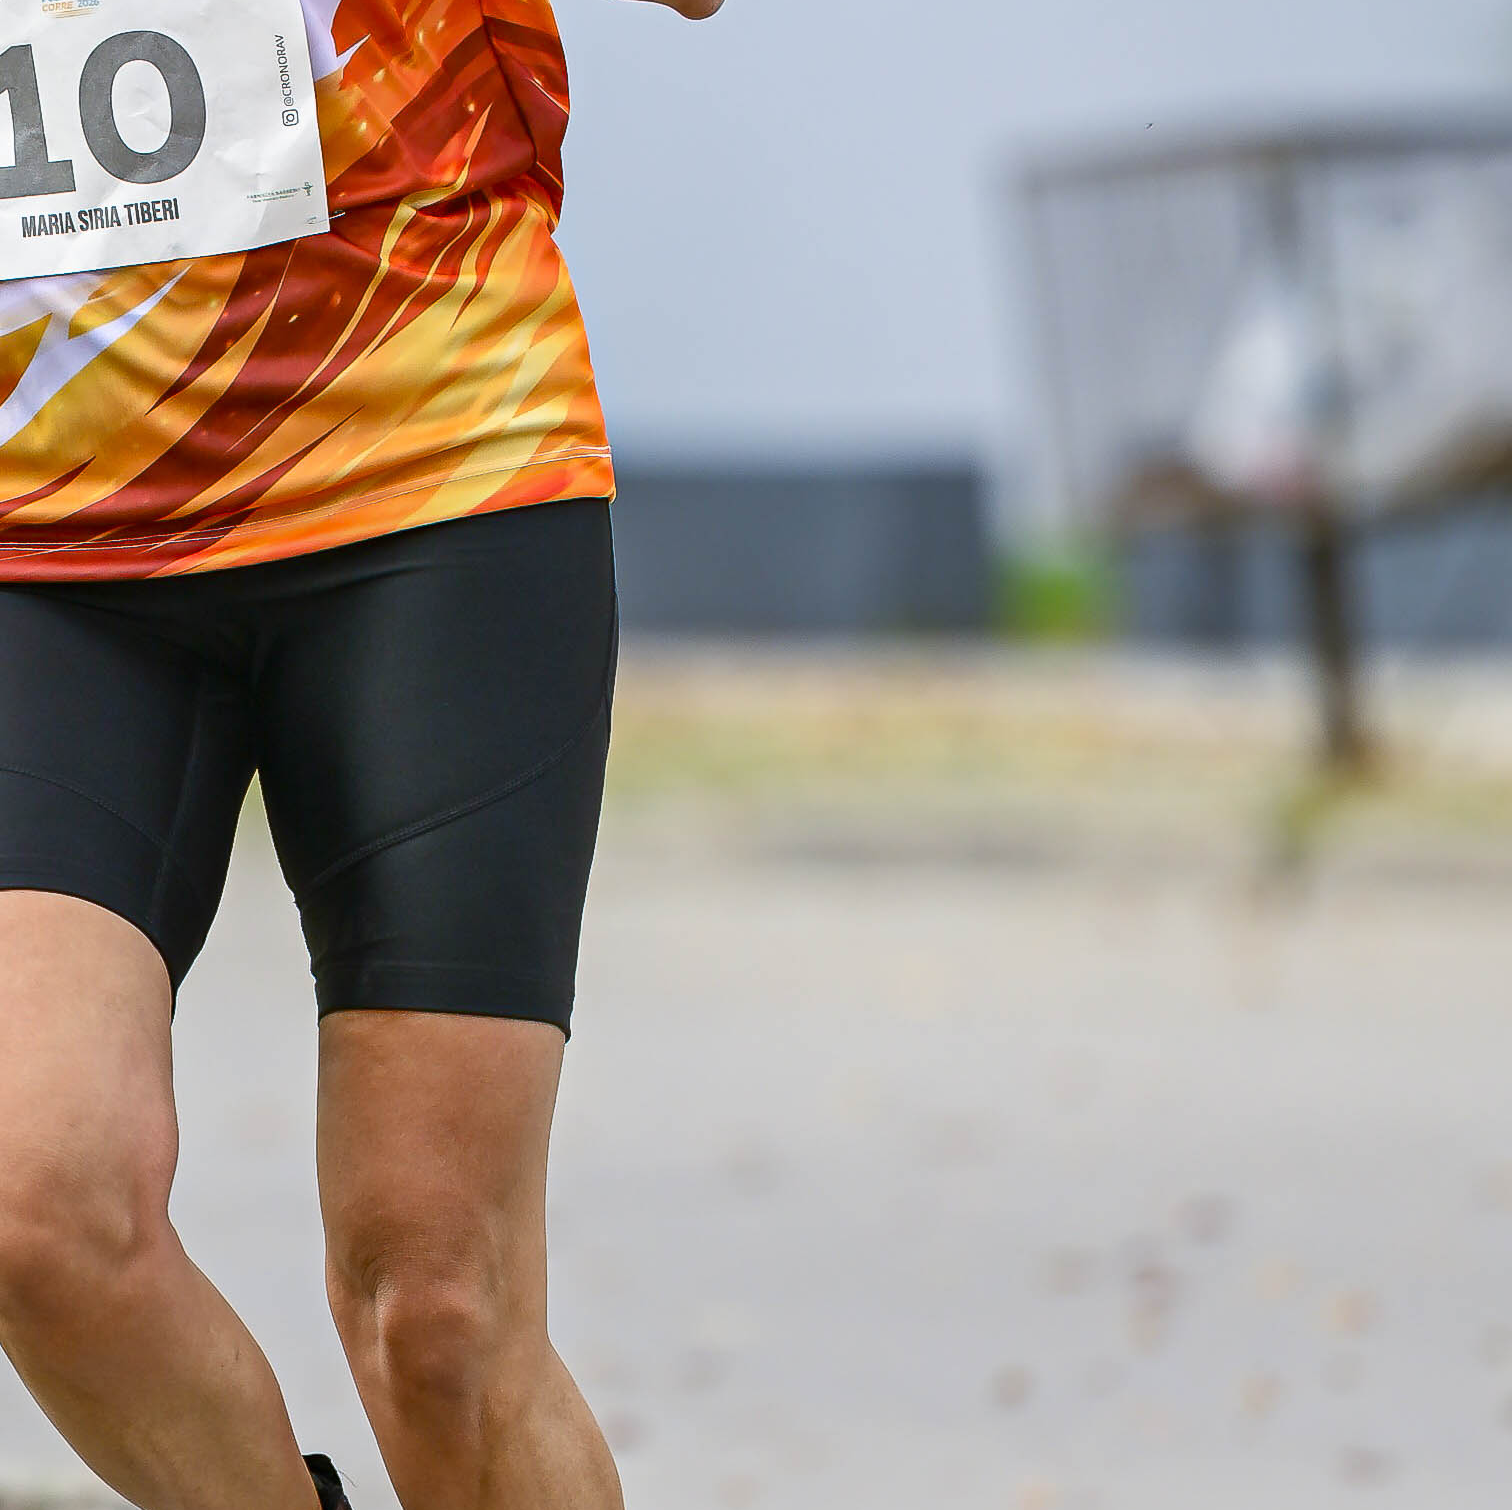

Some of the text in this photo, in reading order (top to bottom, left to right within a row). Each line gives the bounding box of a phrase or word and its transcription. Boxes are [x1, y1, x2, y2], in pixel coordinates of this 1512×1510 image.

[42, 1, 73, 12] CORRE
[275, 34, 294, 107] @CRONORAV
[21, 197, 180, 238] MARIA SIRIA TIBERI
